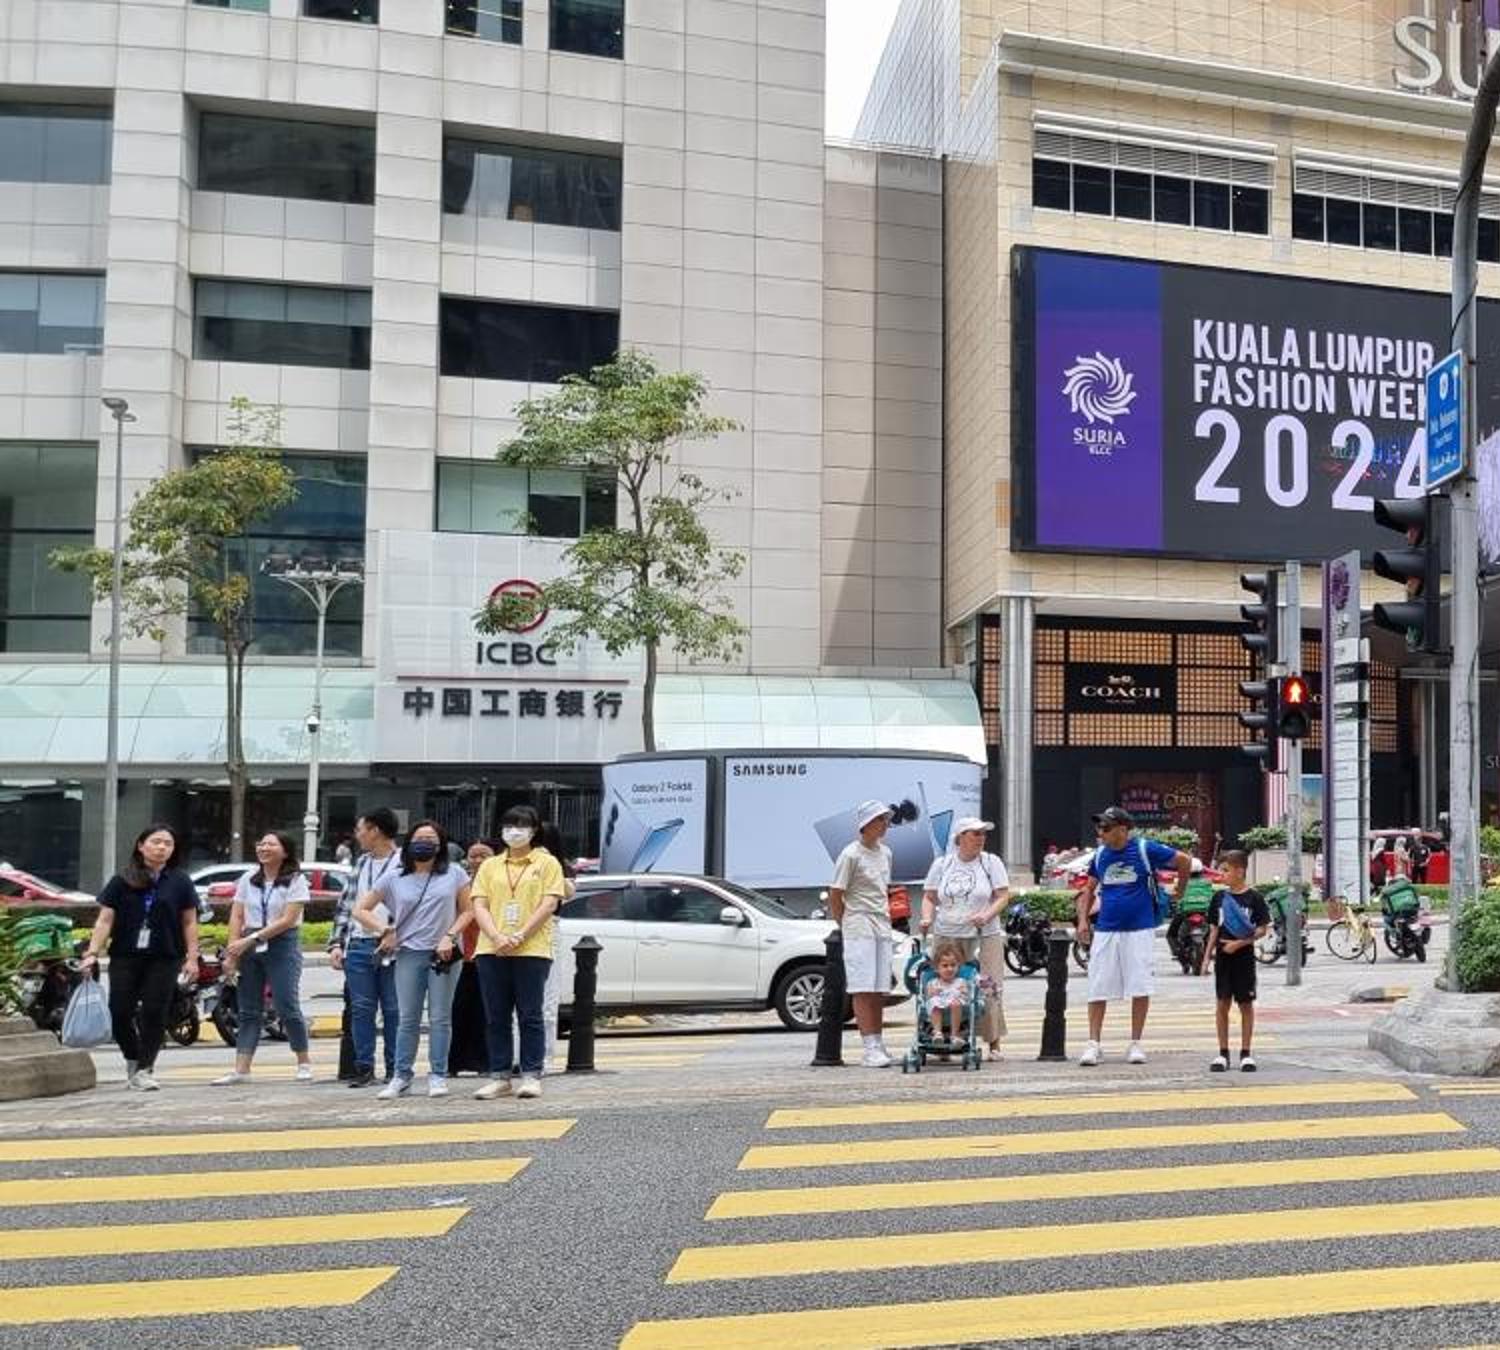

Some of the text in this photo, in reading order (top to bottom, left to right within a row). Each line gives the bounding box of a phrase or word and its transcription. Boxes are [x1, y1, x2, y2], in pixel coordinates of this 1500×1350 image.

[1193, 319, 1434, 379] KUALA LUMPUR
[1194, 364, 1335, 414] FASHION
[1073, 427, 1127, 446] SURIA
[476, 641, 557, 666] ICBC
[403, 686, 623, 719] 中国工商银行
[1081, 685, 1160, 698] COACH
[732, 763, 808, 777] SAMSUNG
